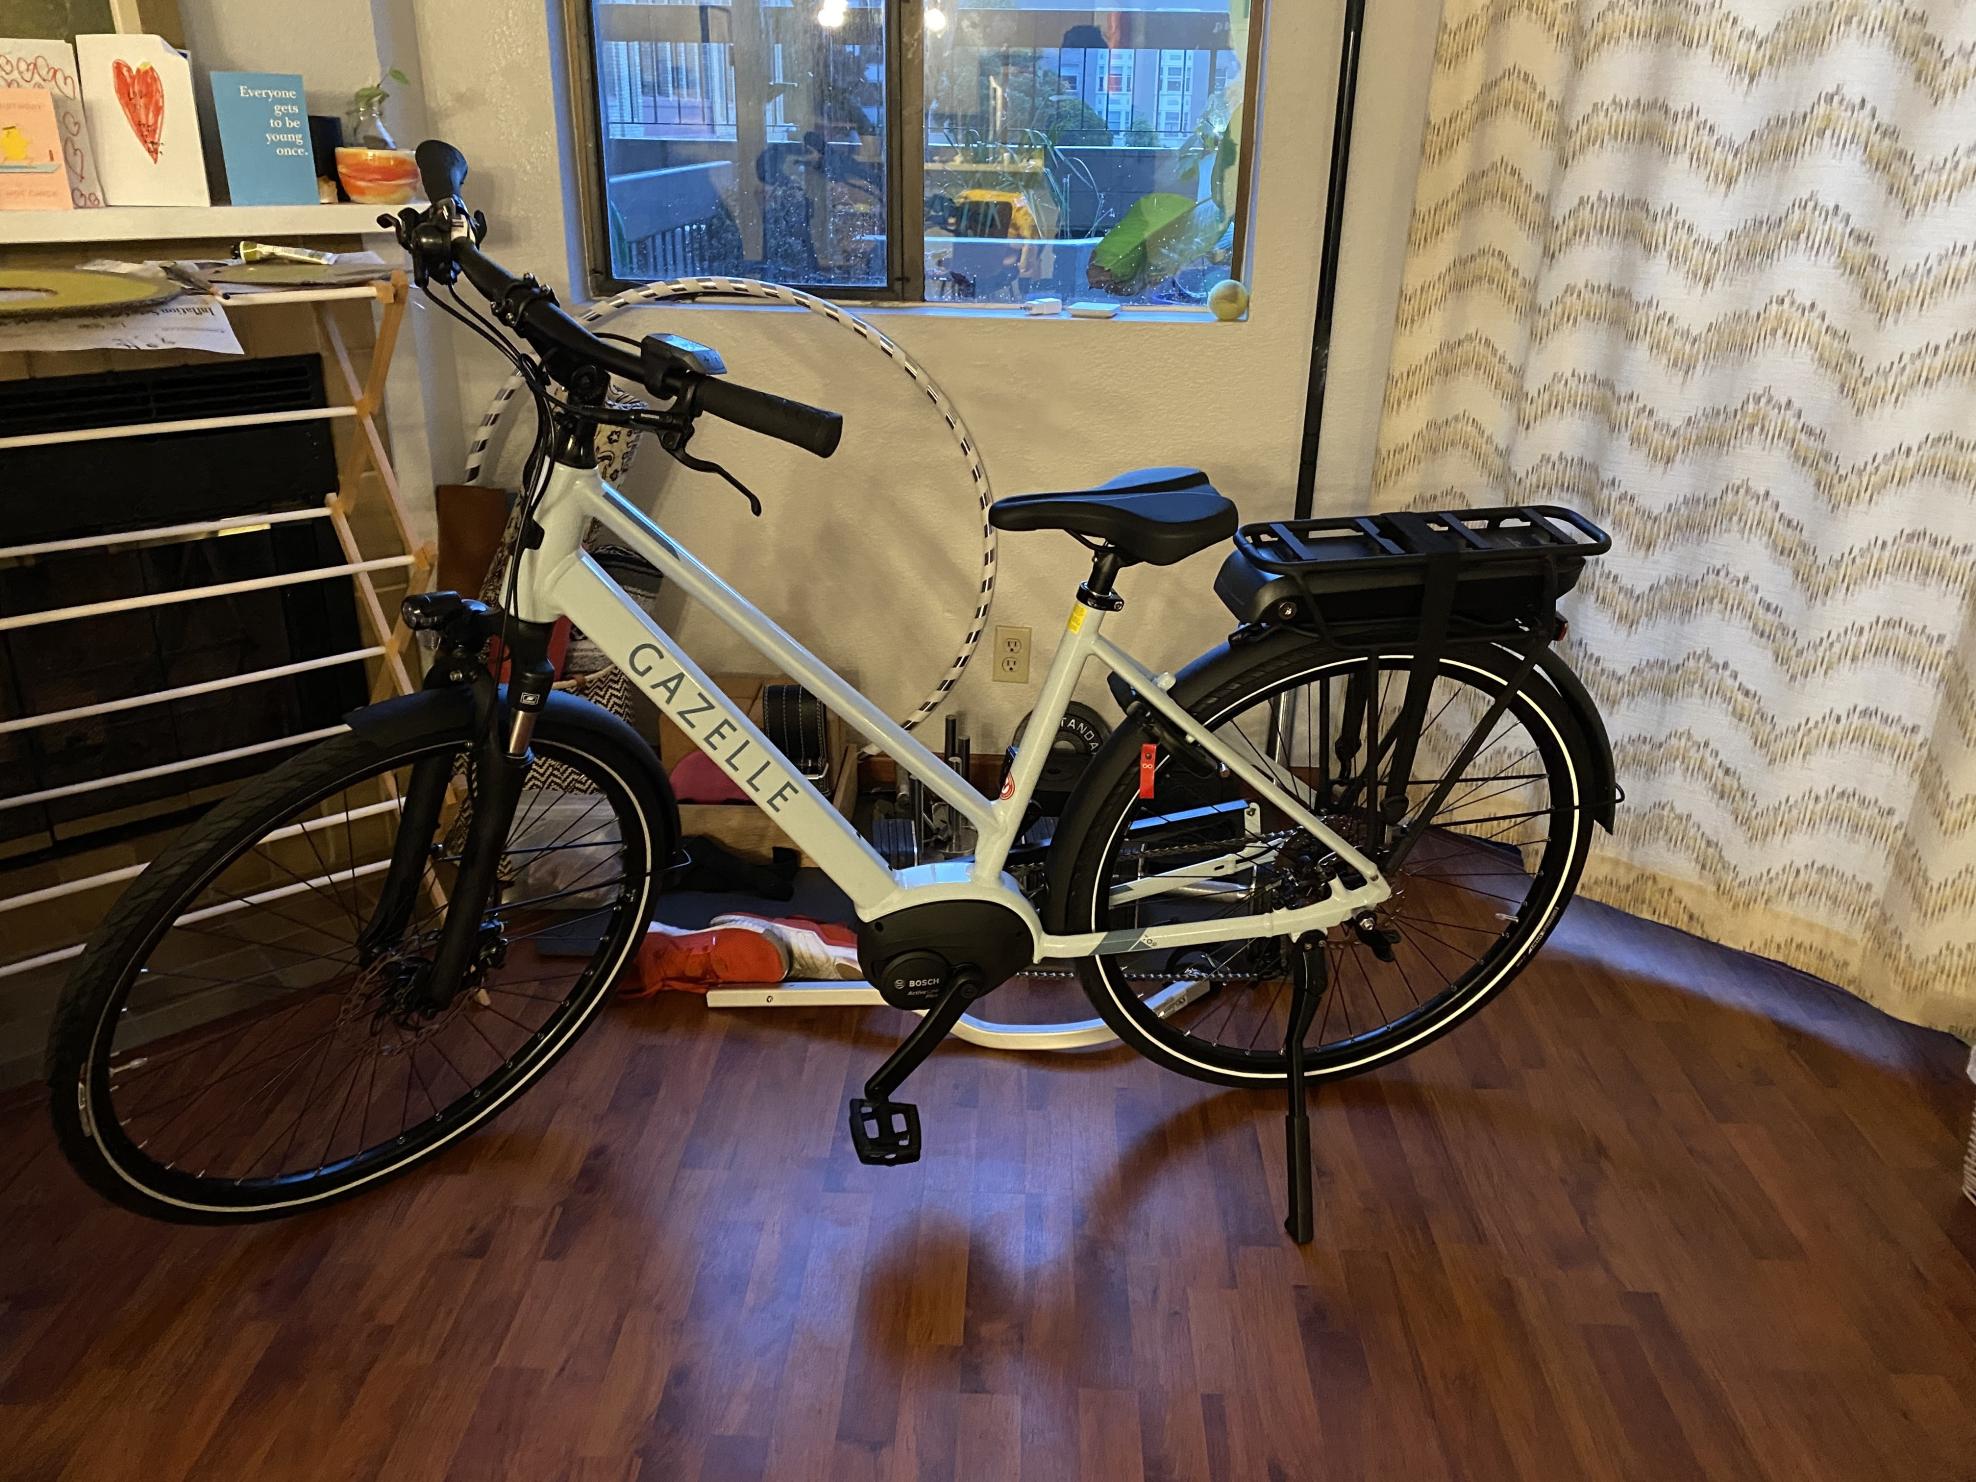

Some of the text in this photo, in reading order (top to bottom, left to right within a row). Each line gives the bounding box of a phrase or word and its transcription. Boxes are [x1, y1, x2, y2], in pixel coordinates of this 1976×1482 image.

[239, 85, 297, 102] Everyone
[273, 104, 299, 115] gets
[270, 117, 301, 128] to be
[265, 132, 304, 145] young
[276, 148, 309, 156] once.
[160, 307, 216, 317] Inflation
[628, 642, 800, 813] GAZELLE
[1060, 718, 1099, 754] TANDA
[909, 978, 940, 988] BOSCH
